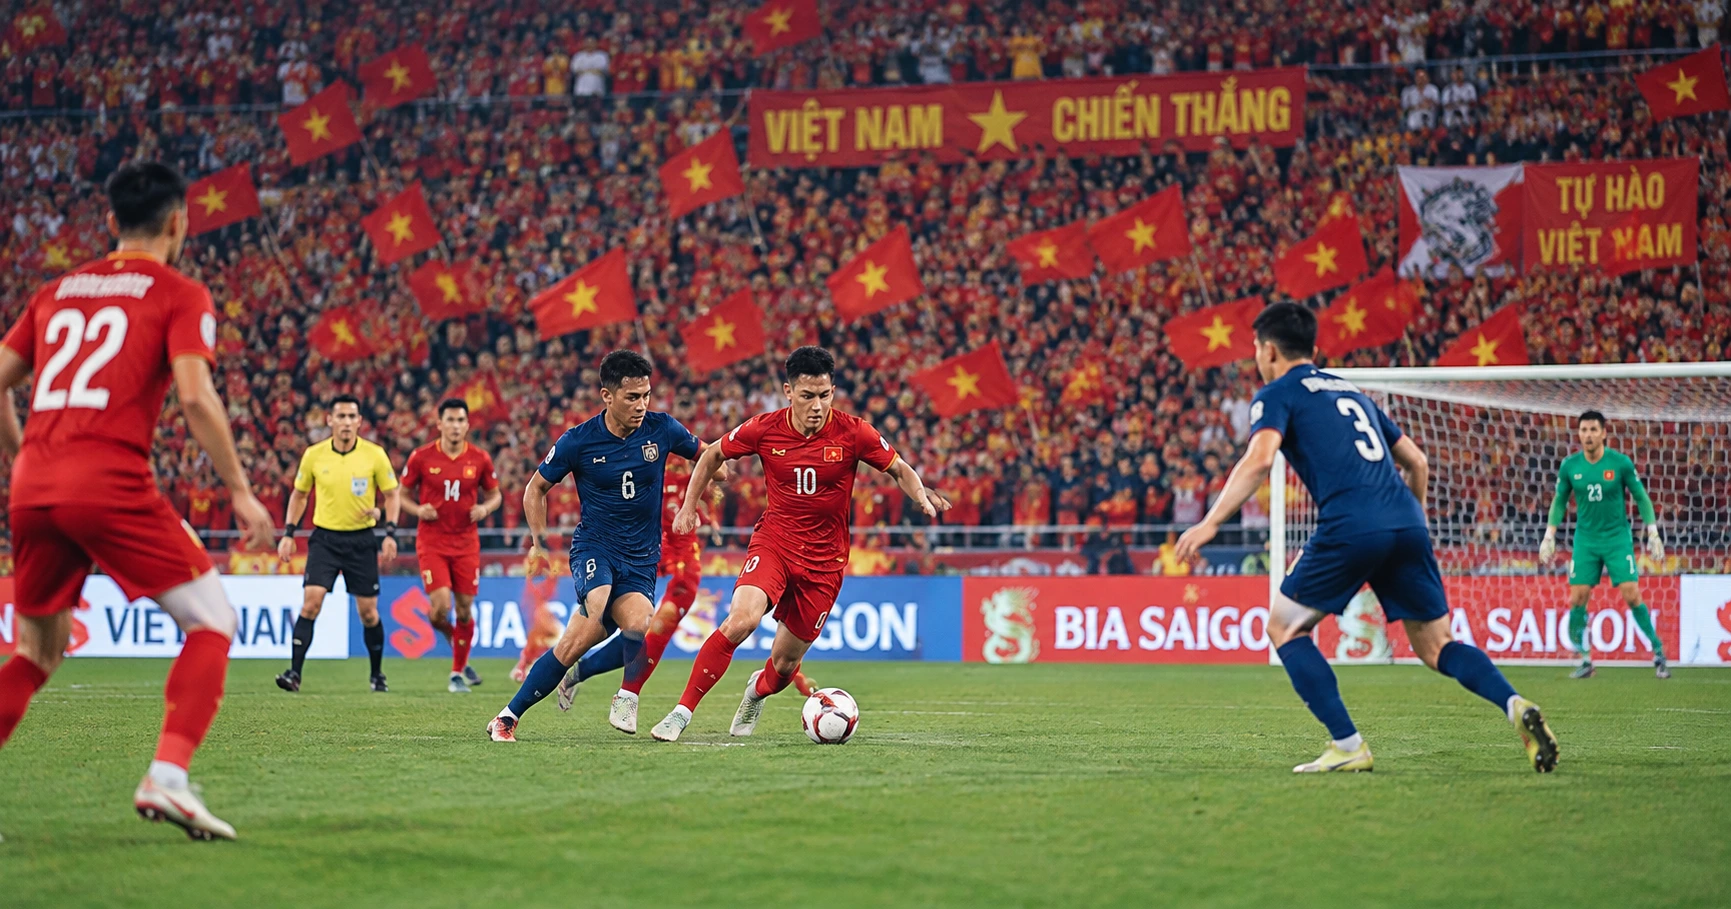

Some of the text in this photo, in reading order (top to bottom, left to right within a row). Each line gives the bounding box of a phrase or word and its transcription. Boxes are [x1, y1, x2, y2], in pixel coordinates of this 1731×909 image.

[764, 98, 845, 161] VIỆT
[856, 104, 943, 150] NAM
[1053, 80, 1161, 142] CHIẾN
[1556, 165, 1665, 219] TỰ HÀO
[1538, 220, 1683, 272] VIỆT NAM
[33, 305, 128, 412] 22
[1336, 397, 1384, 462] 3
[444, 479, 460, 502] 14
[621, 471, 636, 499] 6
[794, 467, 816, 495] 10
[1587, 483, 1603, 502] 23
[1054, 606, 1131, 650] BIA
